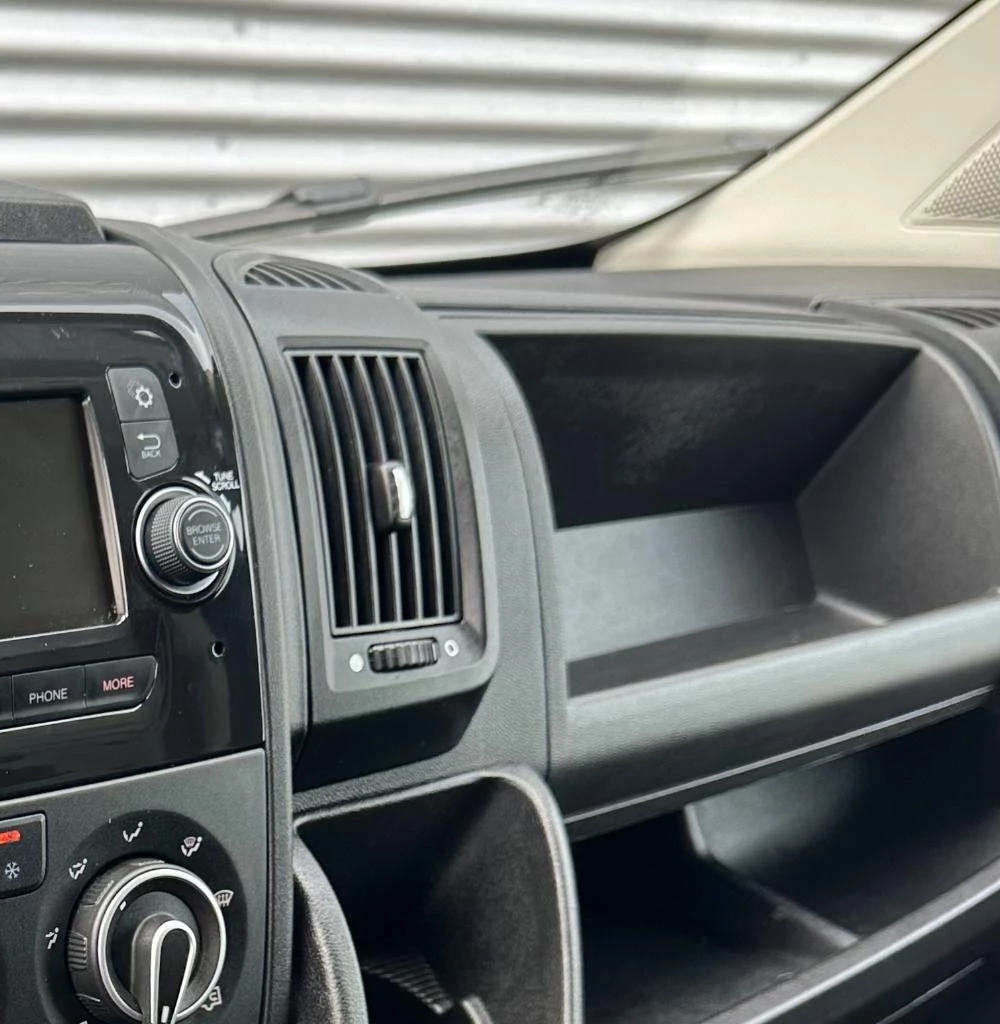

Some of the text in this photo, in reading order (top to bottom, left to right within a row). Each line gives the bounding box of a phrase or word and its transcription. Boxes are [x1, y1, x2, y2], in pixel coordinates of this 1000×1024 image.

[141, 450, 161, 459] BACK
[213, 470, 235, 482] TUNE
[211, 480, 240, 492] SCROLL
[185, 523, 222, 536] BROWSE
[192, 532, 221, 547] ENTER
[102, 675, 135, 692] MORE
[28, 687, 69, 705] PHONE
